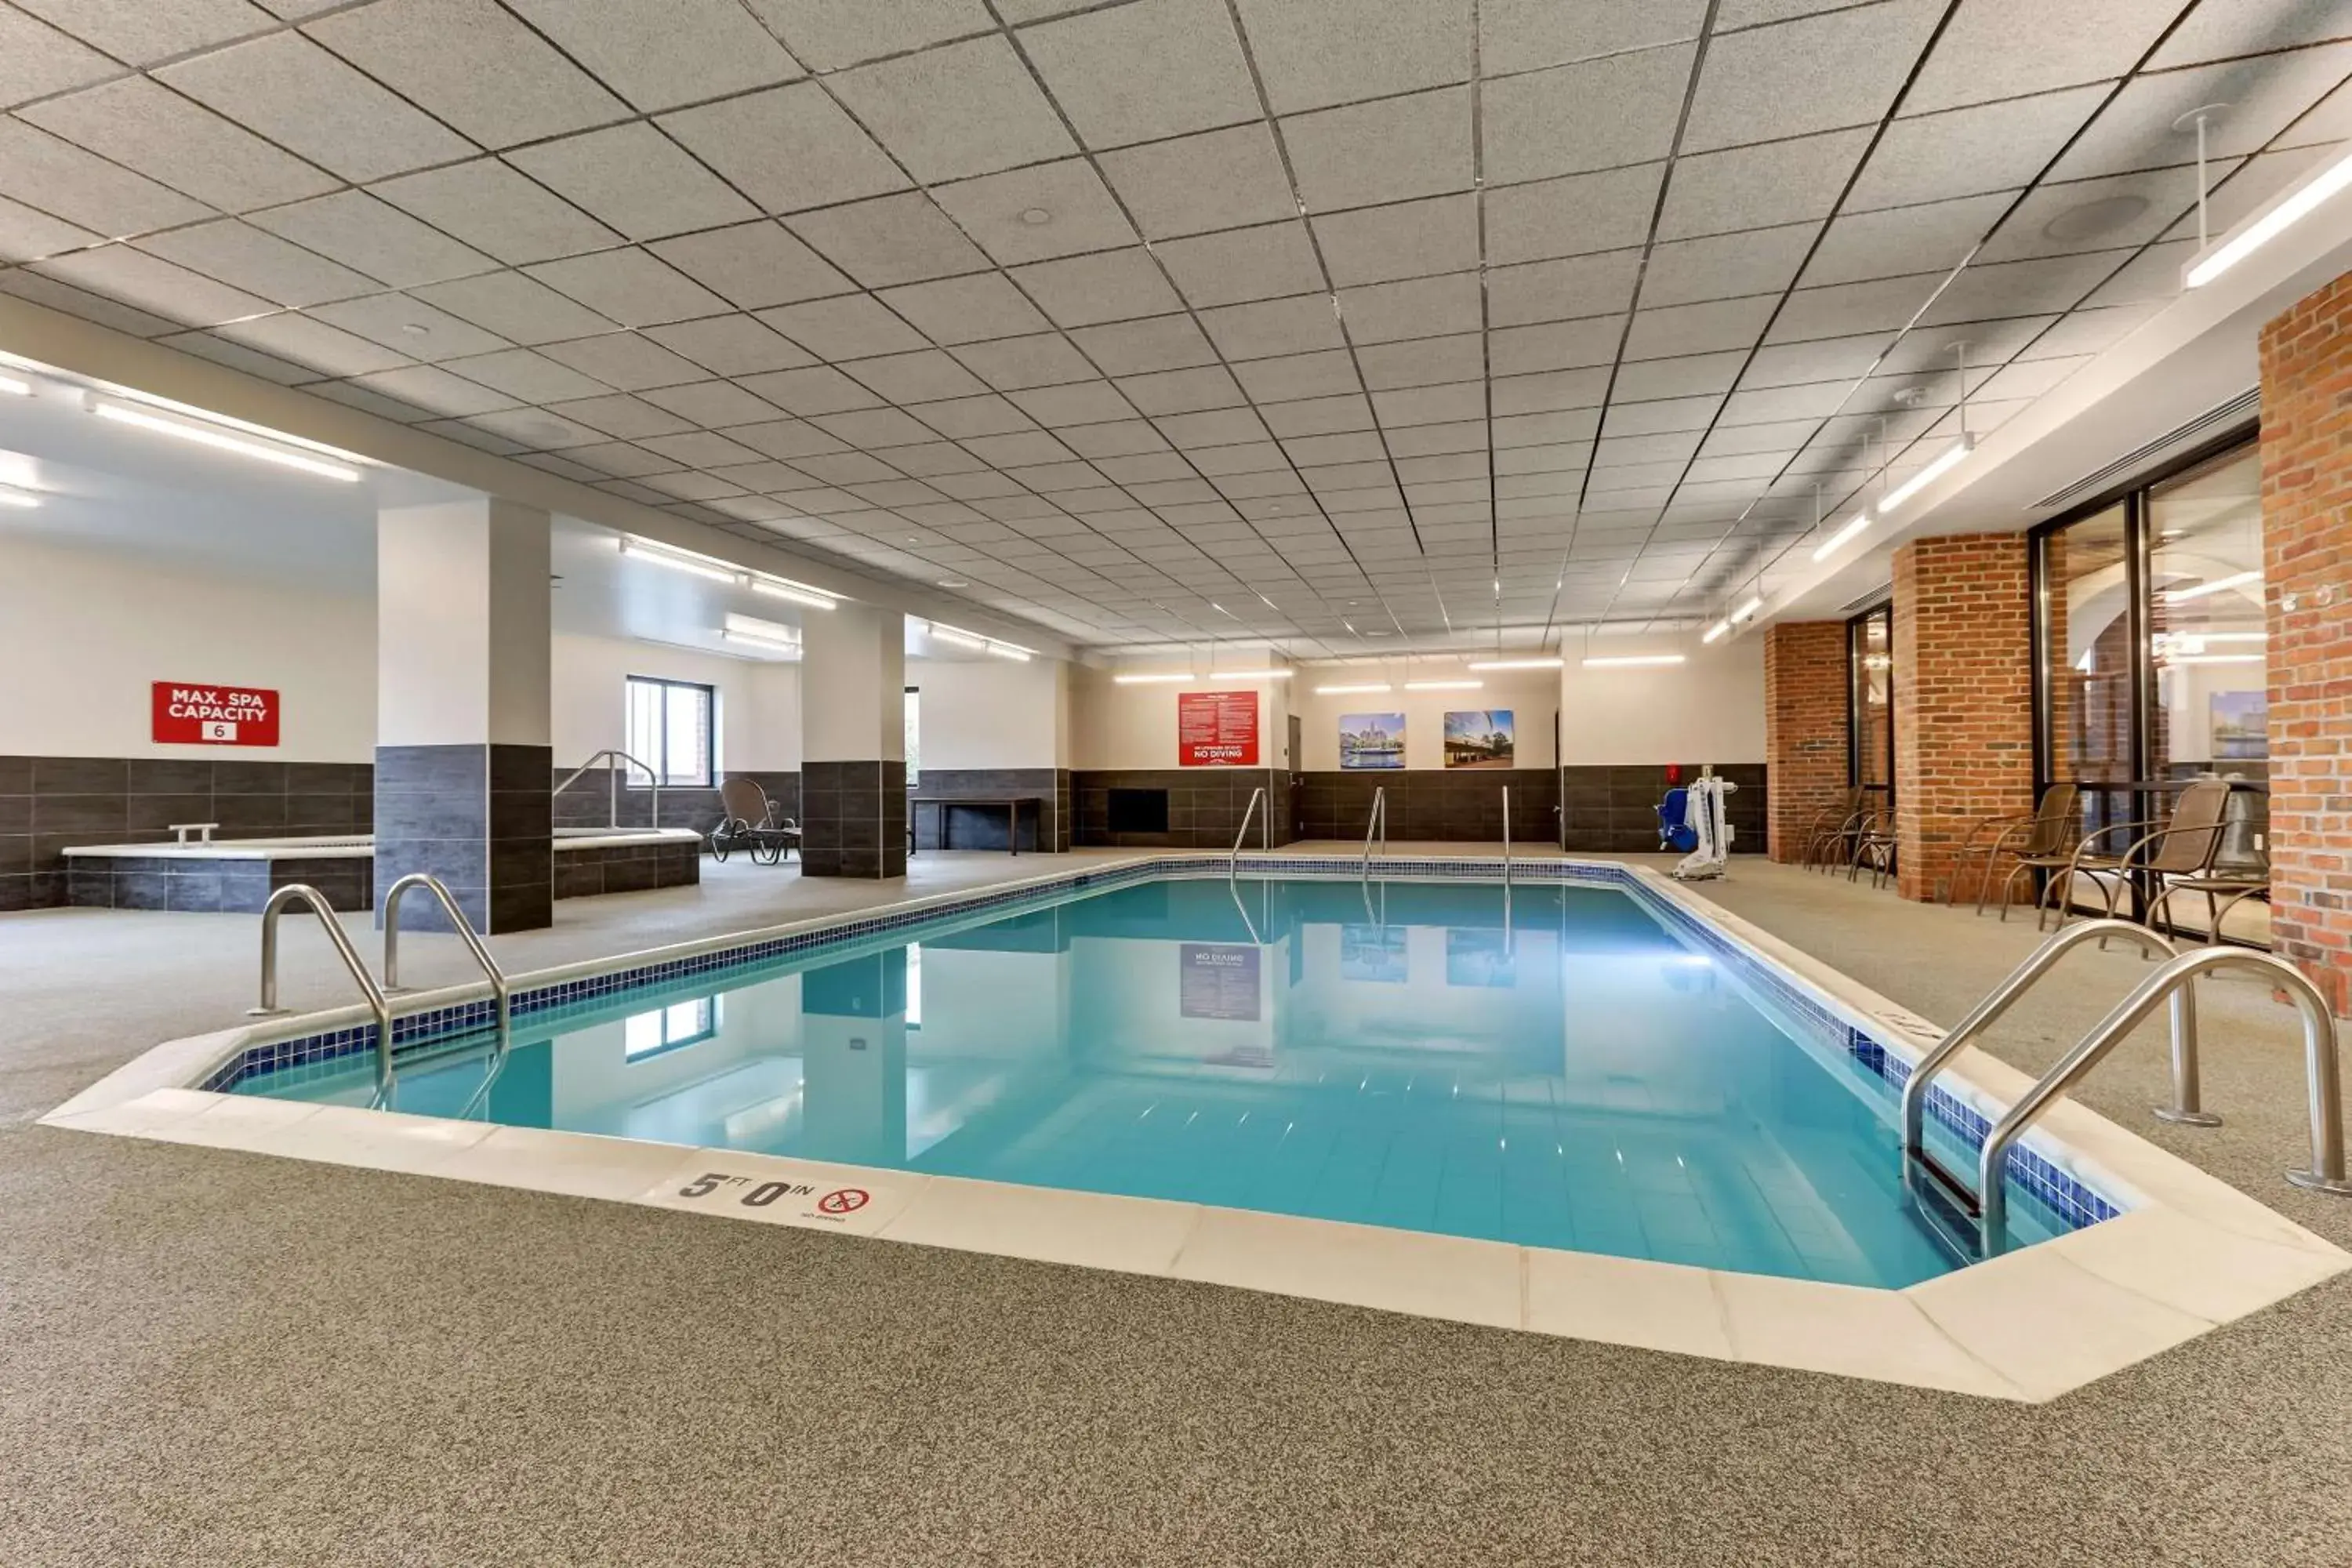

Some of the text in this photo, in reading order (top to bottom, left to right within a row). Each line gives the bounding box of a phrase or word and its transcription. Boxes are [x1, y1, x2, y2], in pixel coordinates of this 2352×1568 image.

[172, 688, 264, 707] MAX. SPA
[169, 703, 267, 722] CAPACITY
[214, 724, 225, 737] 6
[1210, 750, 1242, 758] DIVING
[679, 1173, 815, 1207] 5 FT 0 IN
